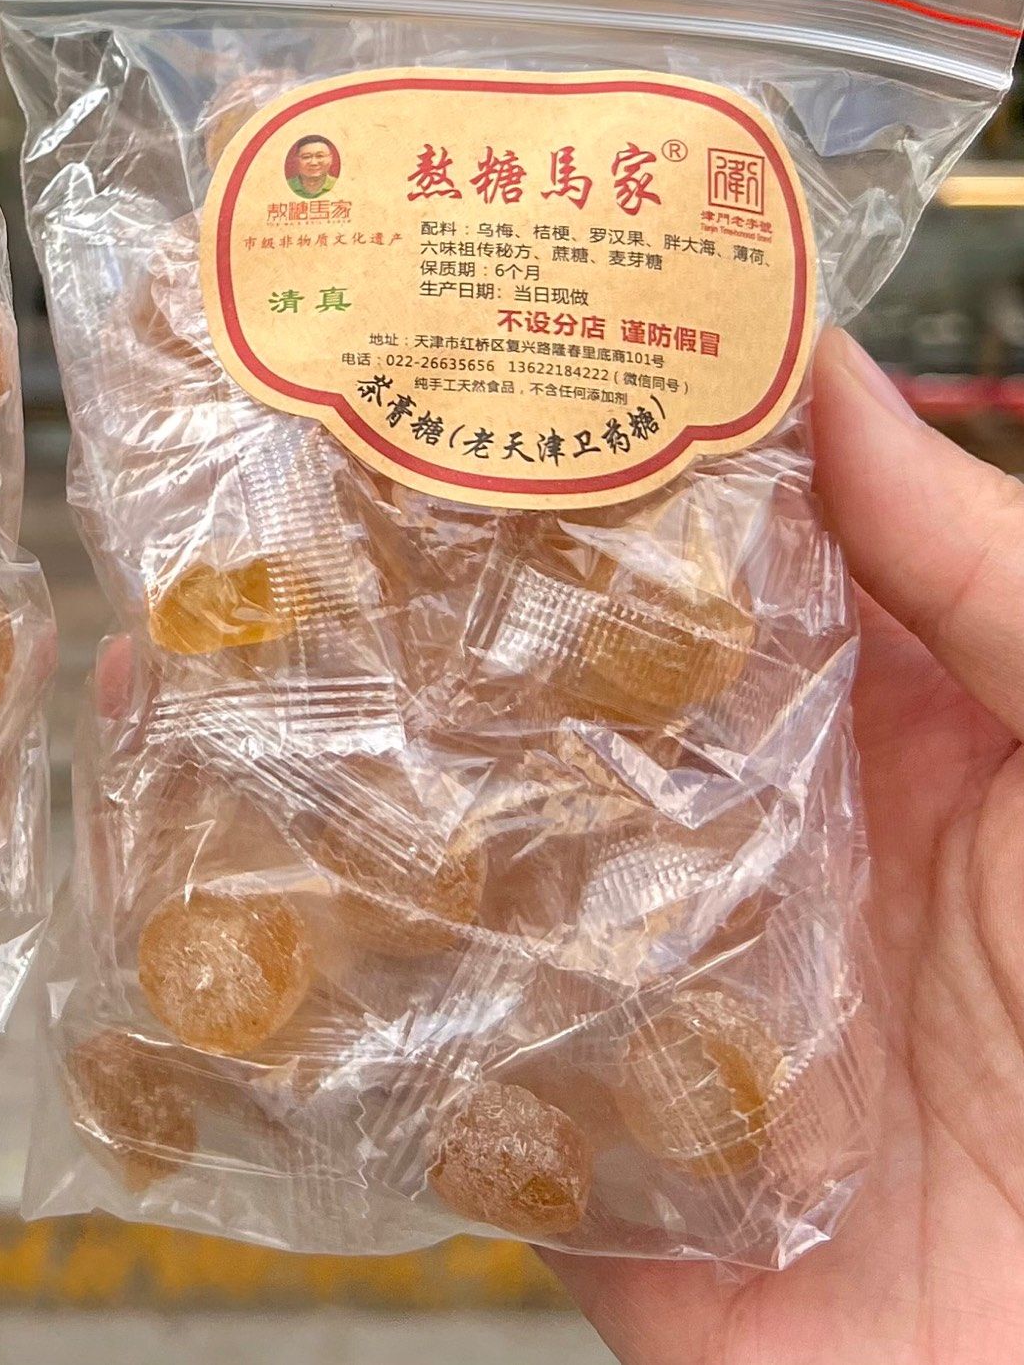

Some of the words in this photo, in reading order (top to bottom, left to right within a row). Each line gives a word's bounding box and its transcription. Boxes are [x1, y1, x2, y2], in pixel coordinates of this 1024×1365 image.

[244, 232, 403, 251] 市级非物质文化遗产
[268, 287, 352, 314] 清真
[497, 310, 605, 340] 不设分店
[621, 318, 720, 357] 谨防假冒
